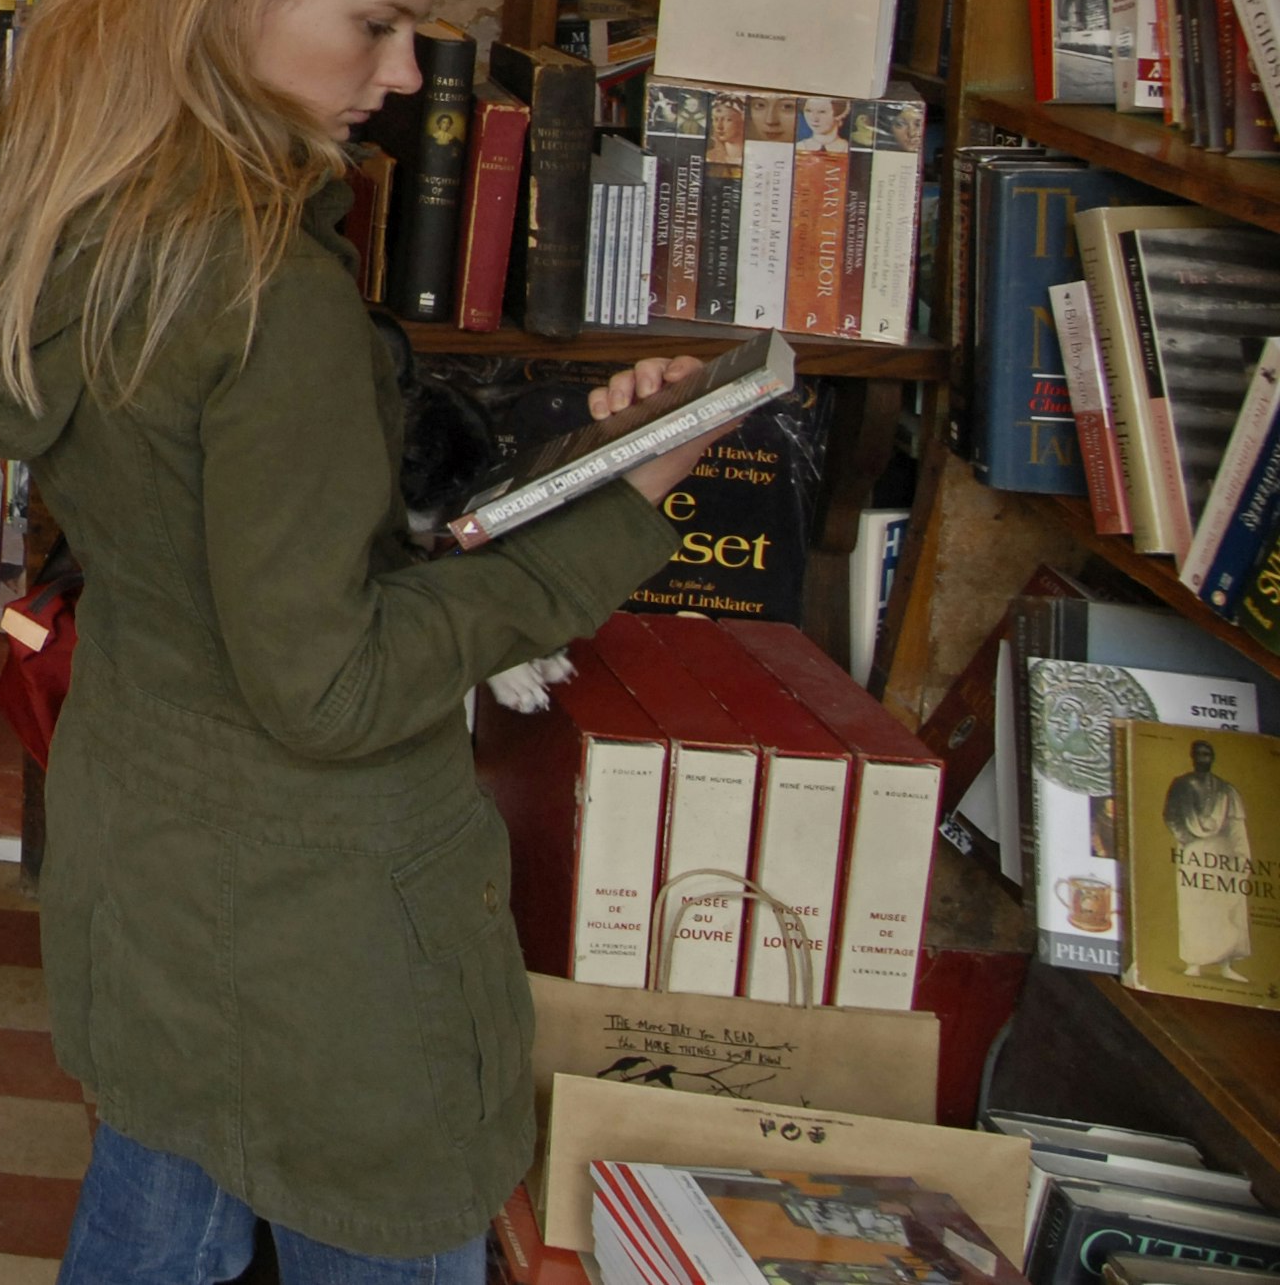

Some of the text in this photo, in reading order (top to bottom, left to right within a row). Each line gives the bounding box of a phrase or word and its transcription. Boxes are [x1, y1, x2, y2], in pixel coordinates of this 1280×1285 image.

[657, 181, 671, 247] CLEOPATRA
[672, 165, 689, 268] ELIZABETH JENKINS
[683, 154, 703, 283] ELIZABETH THE GREAT
[768, 160, 786, 276] Unnatural Murder
[816, 166, 841, 298] MARY TUDOR
[698, 380, 762, 428] IMAGINED
[610, 412, 700, 464] COMMUNITIES
[717, 446, 779, 465] Hawke
[629, 590, 764, 614] ichard Linklater
[1209, 693, 1238, 707] THE
[1190, 705, 1238, 721] STORY
[595, 886, 638, 898] MUSÉES
[608, 905, 622, 914] DE
[868, 910, 907, 923] MUSÉE
[587, 920, 642, 931] HOLLANDE
[879, 929, 894, 938] DE
[851, 943, 915, 958] L'ERMITAGE
[604, 1014, 630, 1029] THE
[667, 1022, 691, 1035] THAT
[617, 1035, 636, 1049] the
[644, 1037, 671, 1053] MORE
[678, 1044, 716, 1057] THINGS
